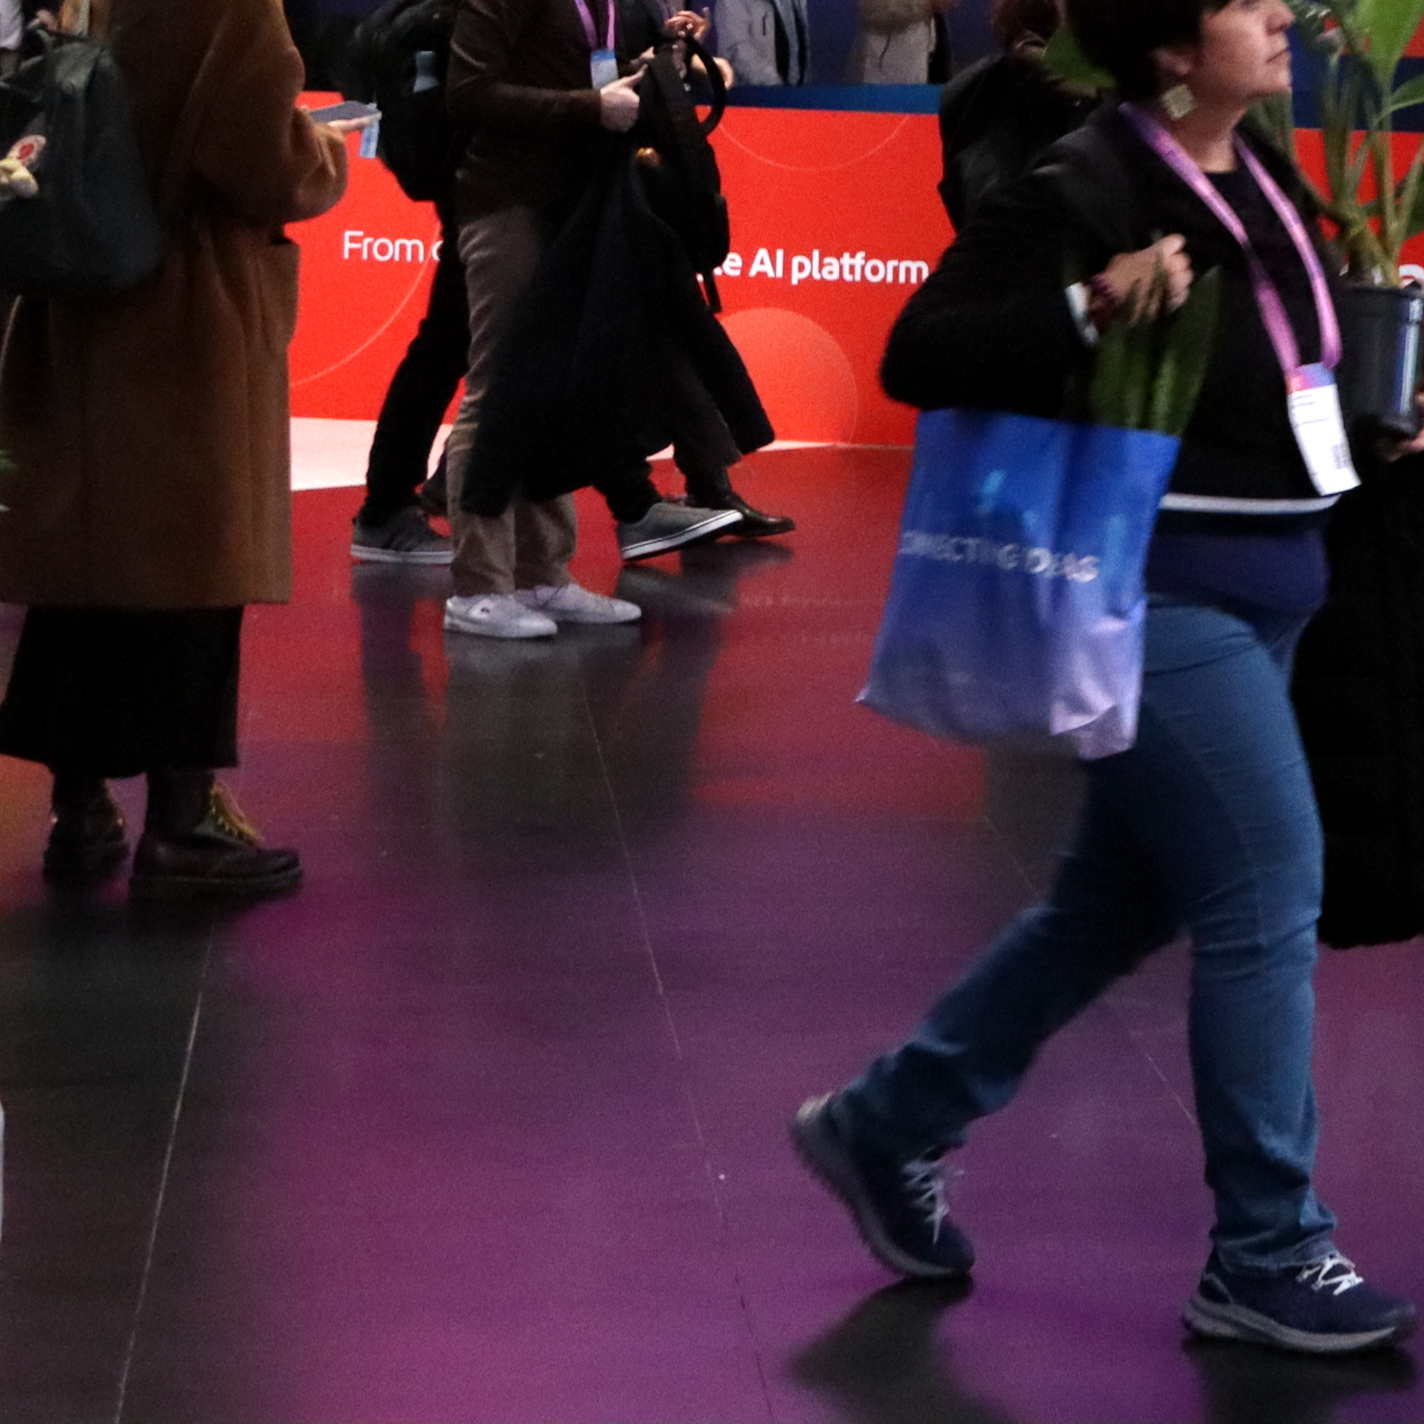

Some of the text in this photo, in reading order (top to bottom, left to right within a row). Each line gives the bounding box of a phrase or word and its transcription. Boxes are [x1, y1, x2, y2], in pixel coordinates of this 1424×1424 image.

[343, 230, 424, 263] From
[748, 247, 784, 278] AI
[791, 249, 929, 285] platform
